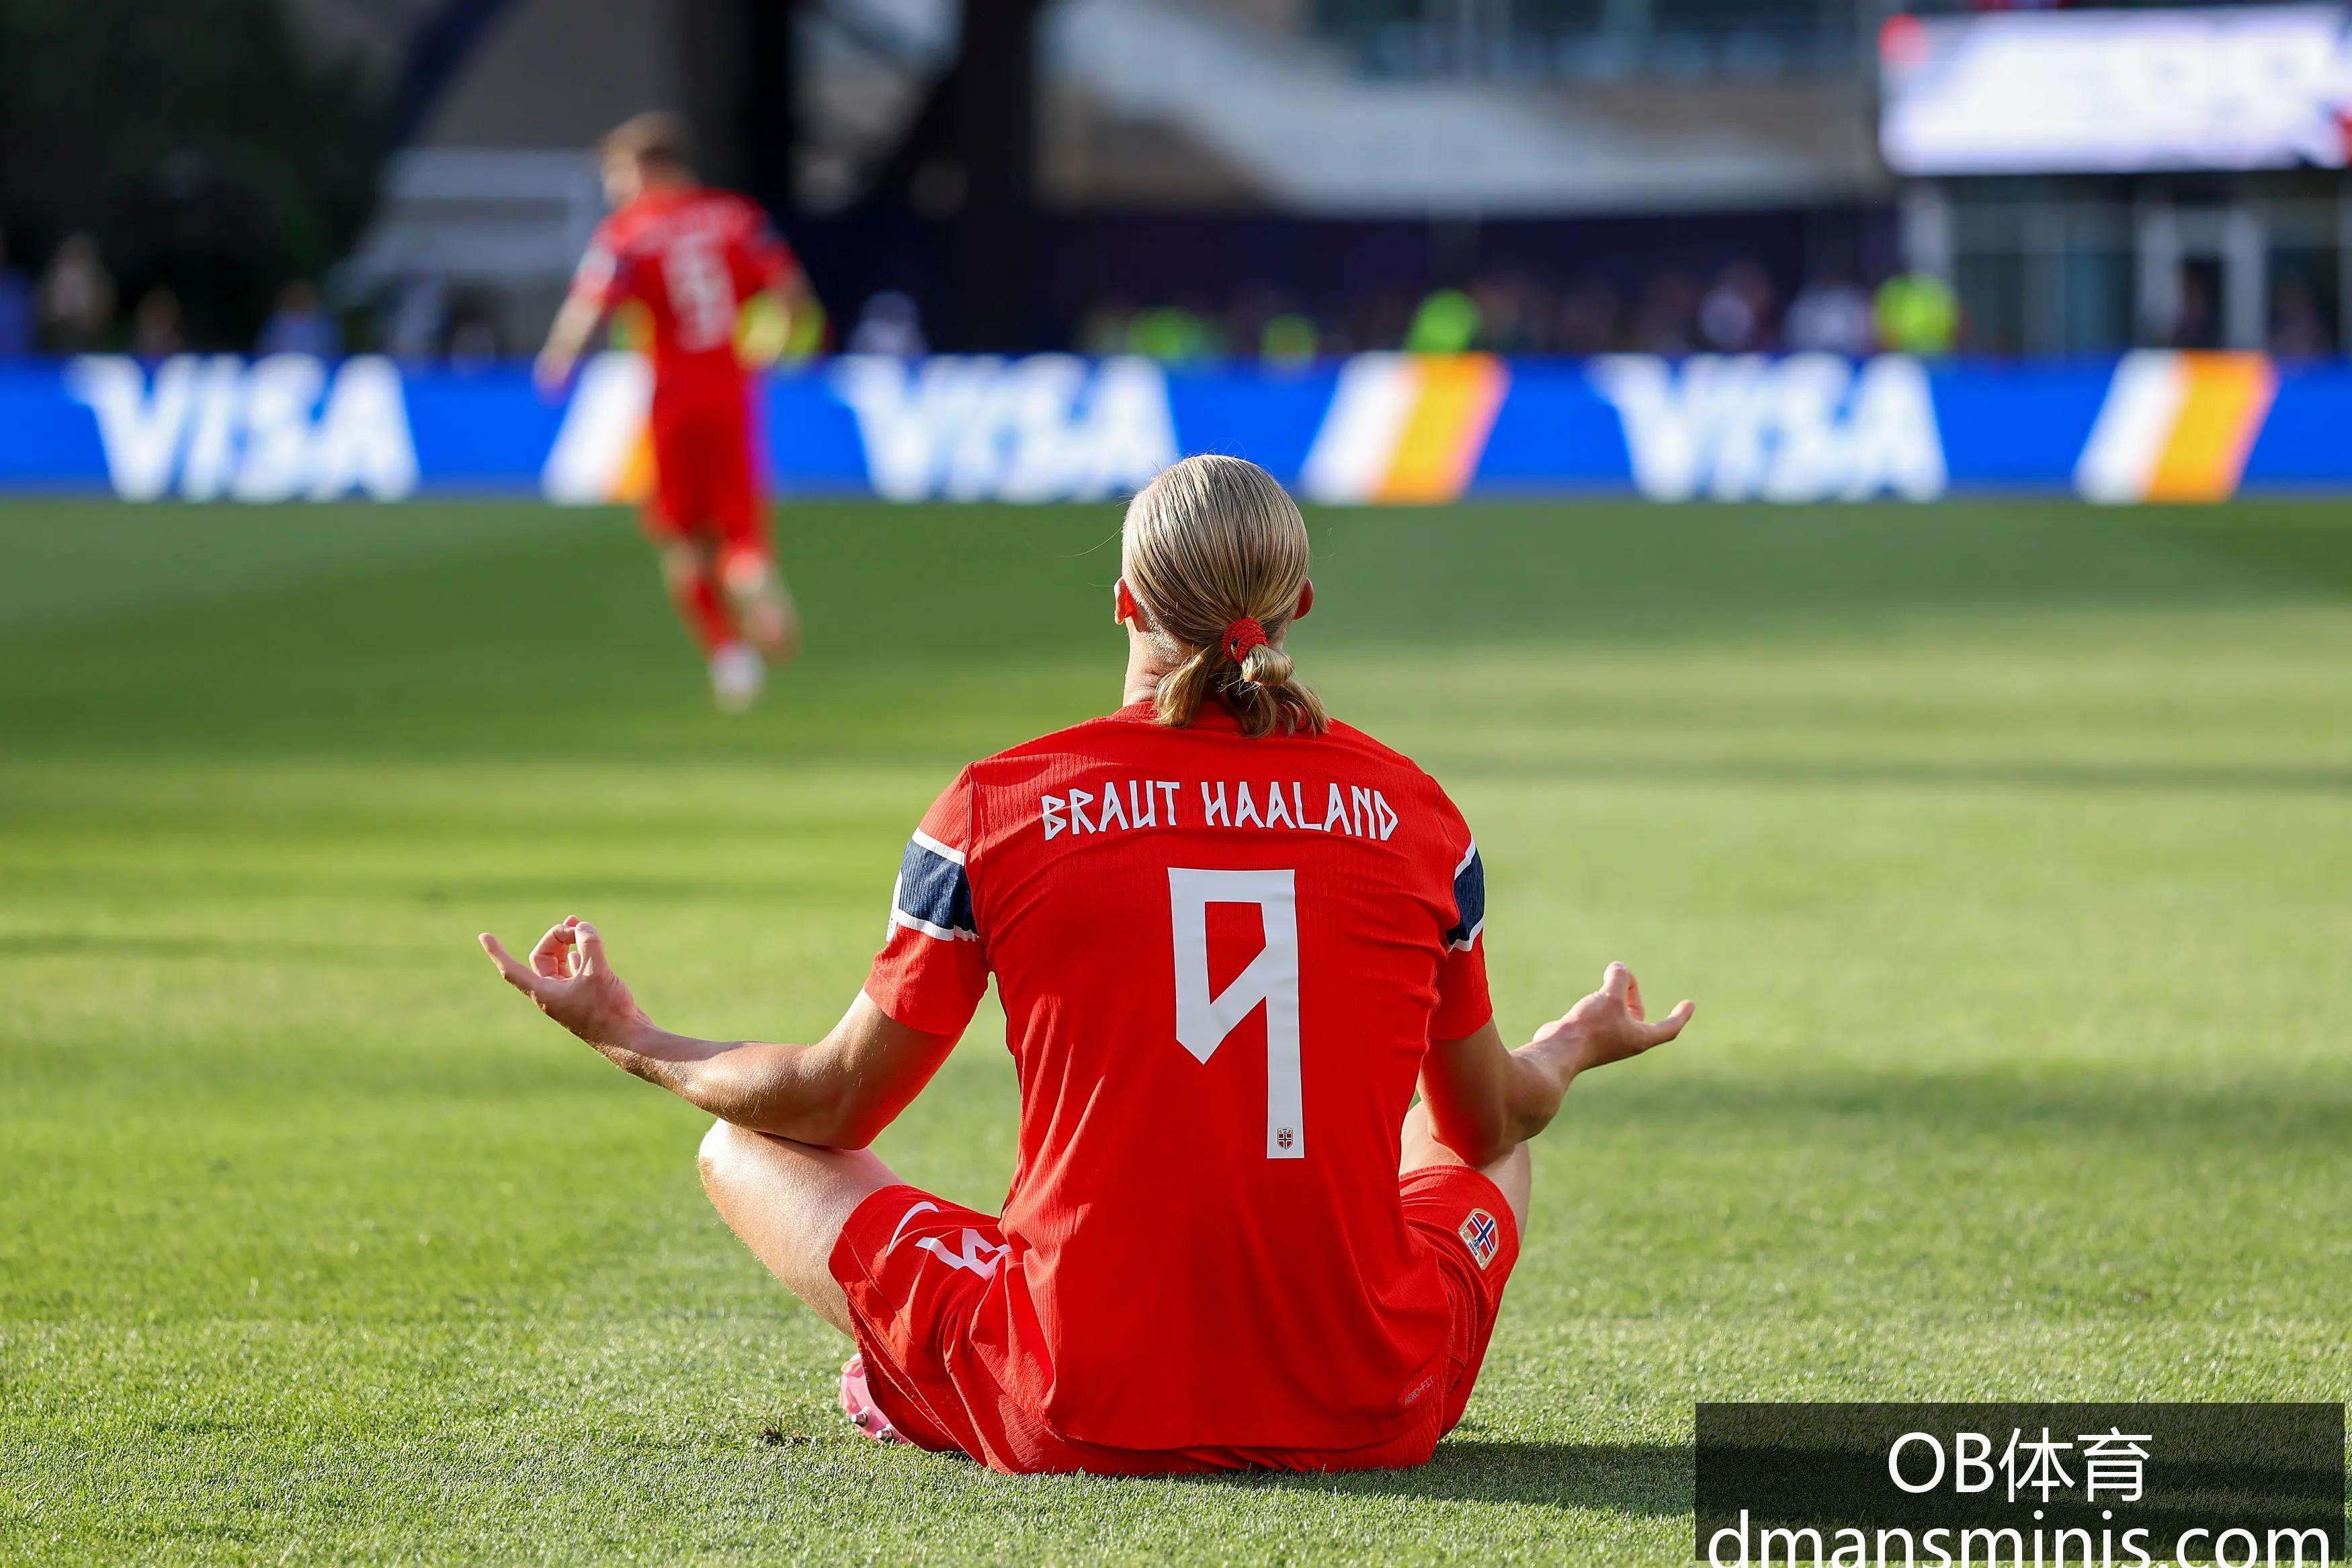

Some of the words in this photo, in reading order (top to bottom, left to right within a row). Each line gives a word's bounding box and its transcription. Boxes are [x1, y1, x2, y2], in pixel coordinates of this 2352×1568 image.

[67, 353, 419, 503] VISA
[833, 353, 1181, 504] VISA
[1582, 353, 1949, 504] VISA
[1041, 780, 1180, 841] BRAUT
[1200, 781, 1398, 841] HAALAND
[1167, 867, 1304, 1159] 9
